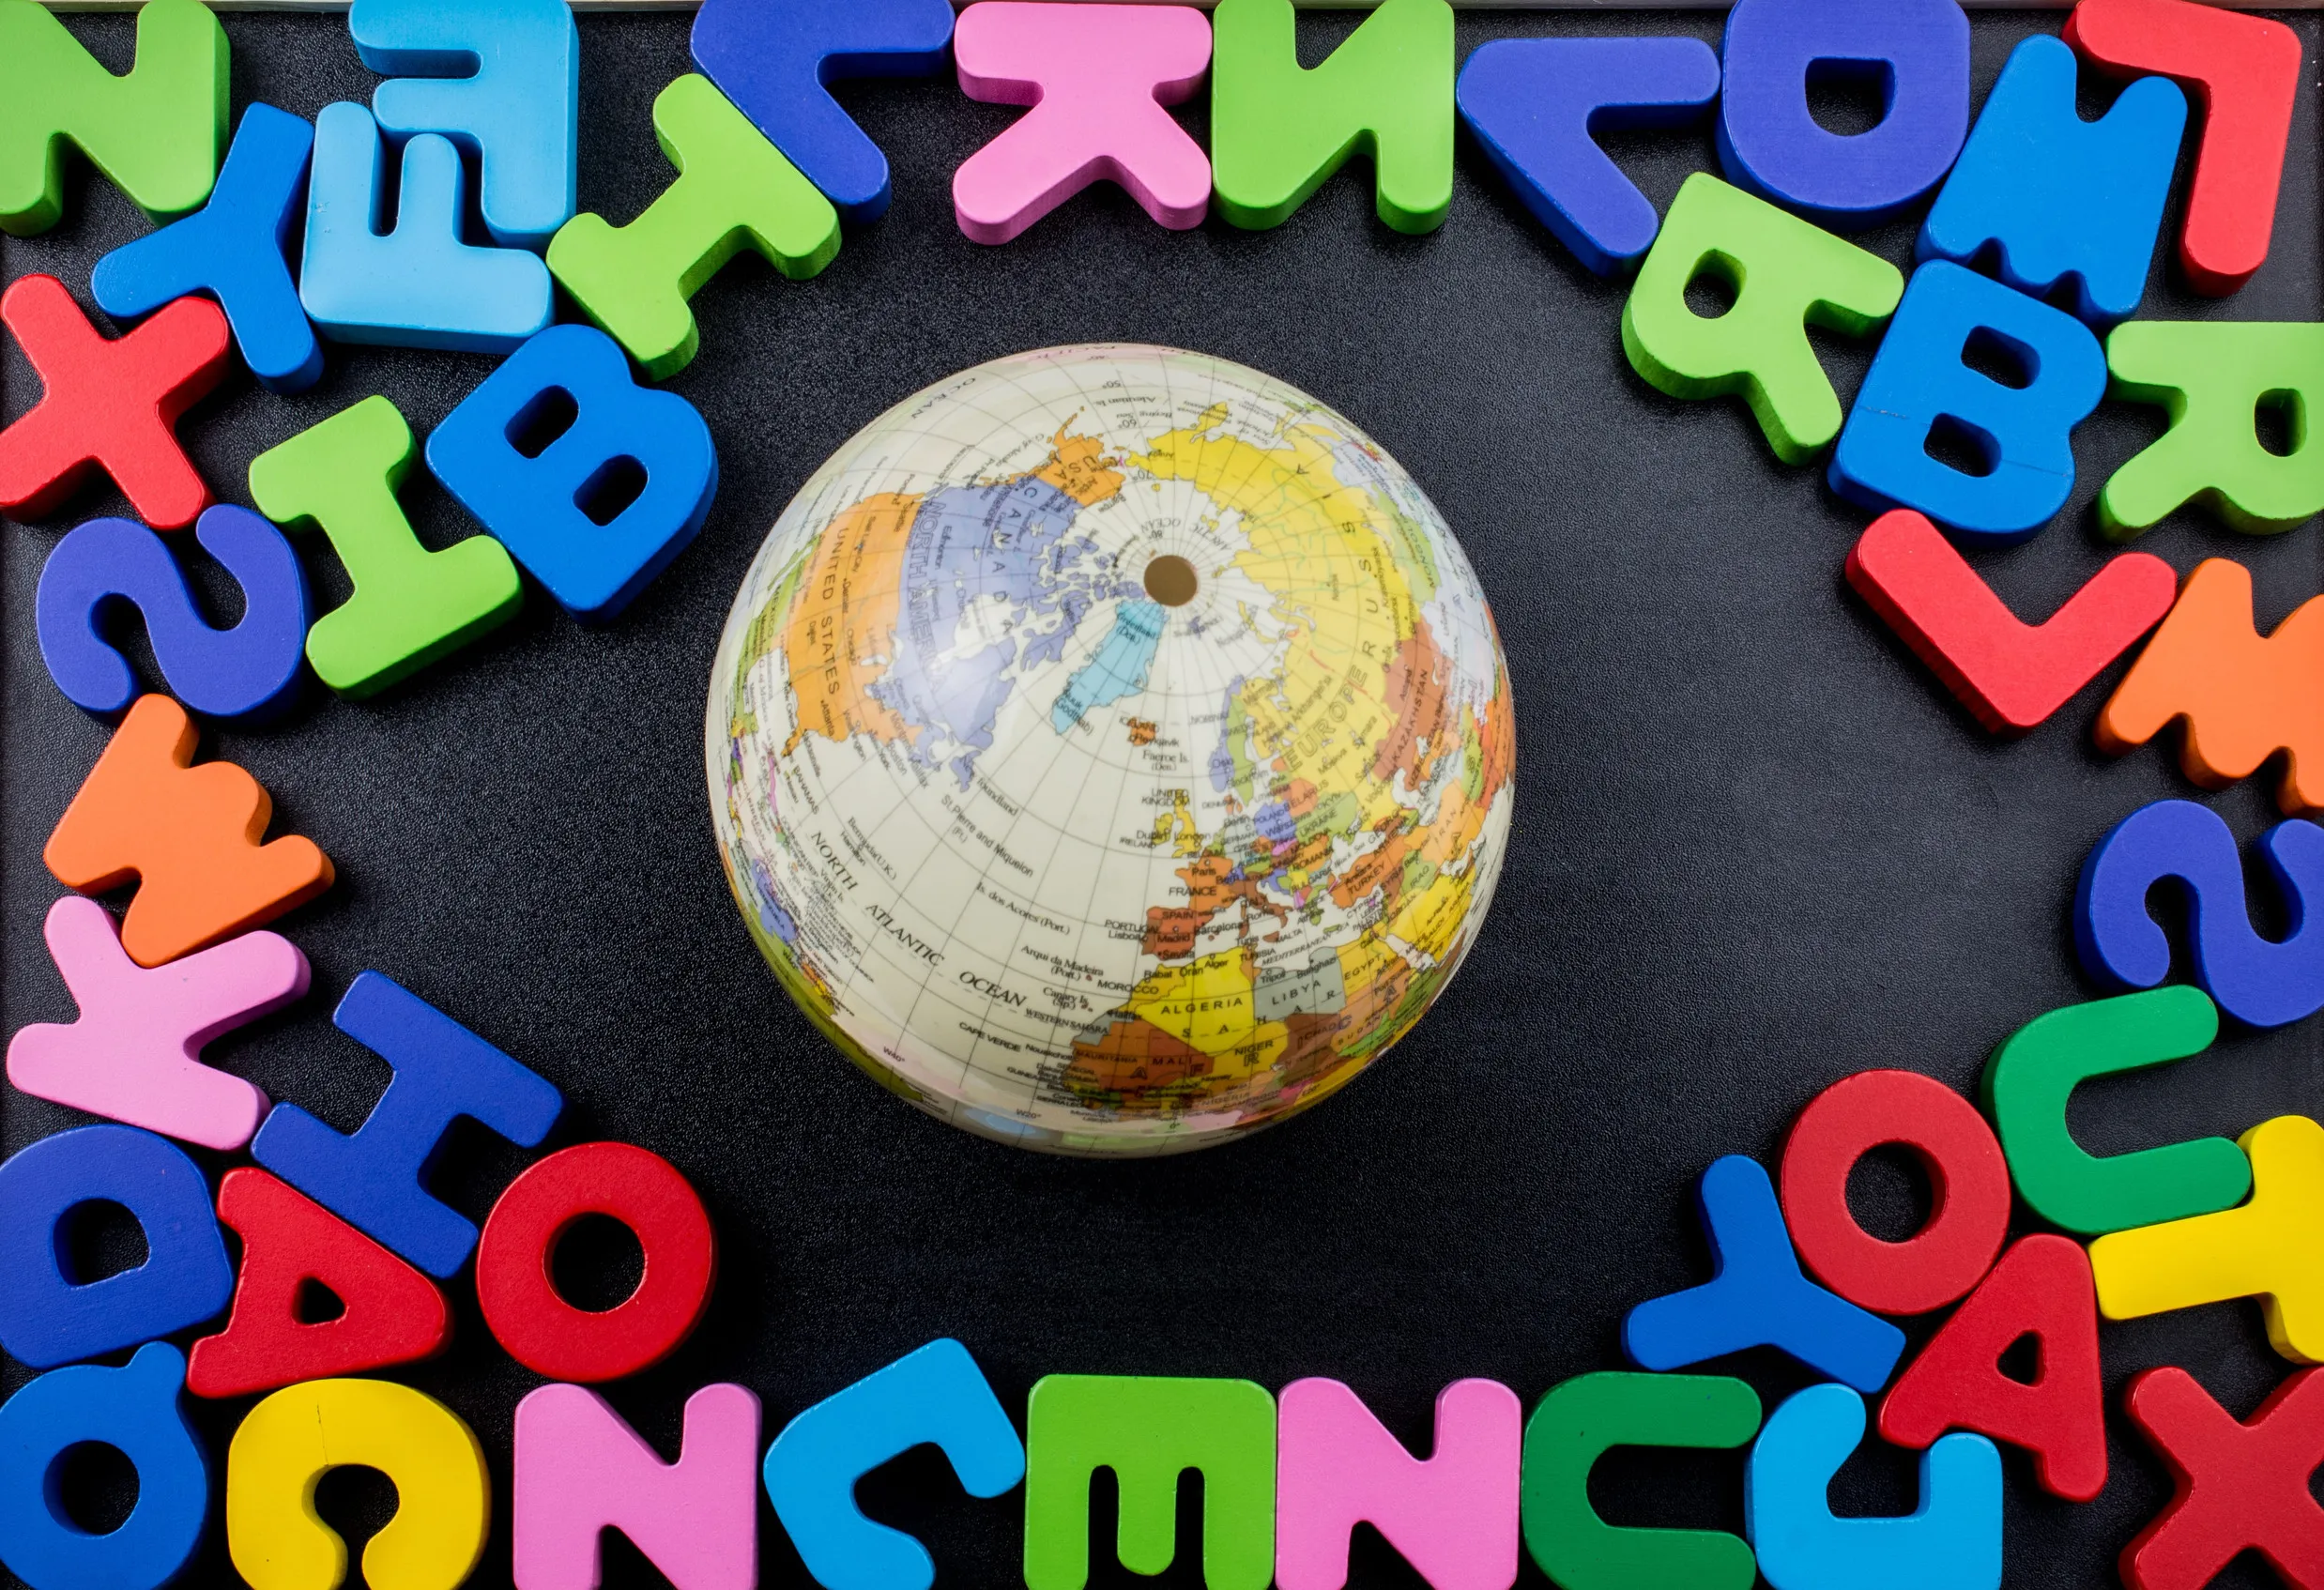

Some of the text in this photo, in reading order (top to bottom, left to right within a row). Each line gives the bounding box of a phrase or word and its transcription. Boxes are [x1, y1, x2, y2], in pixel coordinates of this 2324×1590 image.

[953, 0, 1214, 246] K
[299, 100, 556, 355] F
[92, 101, 325, 394] Y
[0, 273, 231, 530] X
[910, 376, 976, 420] OCEAN
[1827, 258, 2108, 546] B
[2096, 320, 2324, 543] R
[424, 323, 720, 626] B
[908, 499, 946, 579] NORTH
[767, 585, 782, 638] MEXICO
[820, 527, 850, 696] UNITED STATES
[1844, 508, 2179, 734] L
[821, 702, 835, 738] Atlanta
[1285, 664, 1368, 772] EUROPE
[1391, 668, 1428, 764] KAZAKHSTAN
[793, 764, 820, 815] BAHAMAS
[1140, 796, 1190, 807] KINGDOM
[1151, 787, 1189, 798] UNITED
[1252, 808, 1285, 824] POLAND
[1299, 807, 1338, 838] UKRAINE
[1135, 829, 1169, 841] Dublin
[1173, 832, 1212, 842] London
[975, 830, 996, 849] and
[993, 843, 1034, 879] Miquelon
[1191, 866, 1216, 877] Paris
[1168, 886, 1217, 896] FRANCE
[1348, 861, 1384, 894] TURKEY
[987, 891, 1005, 906] dos
[1162, 910, 1194, 920] SPAIN
[811, 830, 859, 892] NORTH
[864, 901, 946, 969] ATLANTIC
[958, 970, 1027, 1008] OCEAN
[1103, 919, 1160, 933] PORTUGAL
[1108, 929, 1142, 940] Lisboa
[1194, 922, 1244, 936] Barcelona
[1276, 927, 1303, 944] MALTA
[1156, 933, 1191, 943] Madrid
[1162, 949, 1196, 960] Sevilla
[1261, 932, 1332, 967] MEDITERRANEAN
[1050, 955, 1063, 966] da
[1063, 957, 1104, 977] Madeira
[1179, 966, 1204, 978] Oran
[1204, 958, 1230, 971] Alger
[1260, 970, 1287, 985] Tripoli
[1343, 954, 1383, 981] EGYPT
[1096, 978, 1160, 995] MOROCCO
[1271, 979, 1322, 1006] LIBYA
[6, 895, 312, 1152] K
[1025, 1007, 1109, 1034] WESTERN SAHARA
[1160, 997, 1244, 1015] ALGERIA
[958, 1021, 1021, 1052] CAPE VERDE
[1338, 1011, 1382, 1046] SUDAN
[1153, 1056, 1192, 1065] MALI
[1234, 1039, 1275, 1056] NIGER
[250, 968, 565, 1280] H
[1778, 1068, 2011, 1316] O
[2088, 1114, 2324, 1366] T
[476, 1140, 717, 1384] O
[1621, 1154, 1907, 1395] Y
[188, 1166, 451, 1400] A
[1880, 1232, 2109, 1503] A
[512, 1382, 762, 1590] N
[1277, 1376, 1522, 1590] N
[2119, 1366, 2324, 1590] X
